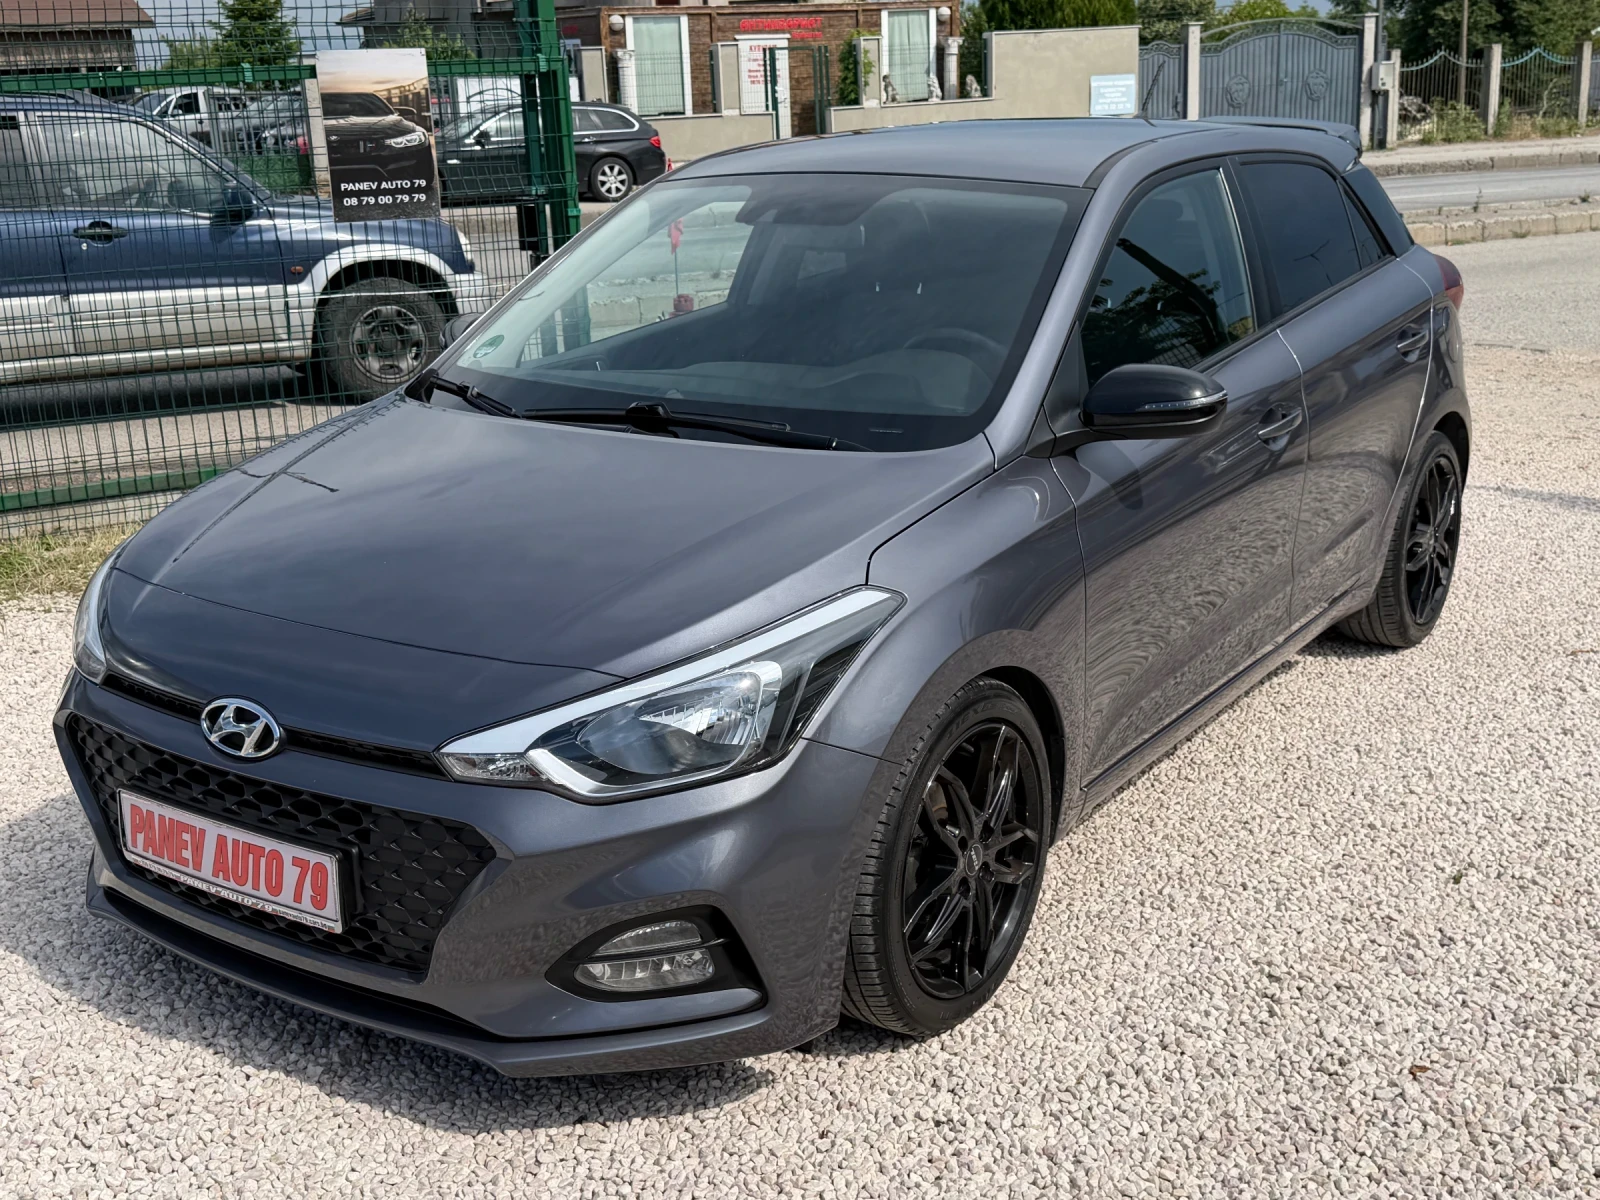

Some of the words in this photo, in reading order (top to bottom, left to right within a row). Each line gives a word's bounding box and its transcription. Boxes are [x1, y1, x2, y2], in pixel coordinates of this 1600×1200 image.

[340, 181, 378, 191] PANEV
[380, 180, 411, 189] AUTO
[413, 179, 427, 188] 79
[343, 197, 358, 206] 08
[360, 196, 376, 205] 79
[378, 195, 393, 204] 00
[395, 194, 410, 203] 79
[412, 193, 427, 202] 79
[130, 803, 206, 873] PANEV
[211, 833, 285, 898] AUTO
[291, 856, 329, 911] 79
[180, 873, 218, 893] PANEV
[220, 889, 252, 905] AUTO
[256, 901, 273, 912] 79
